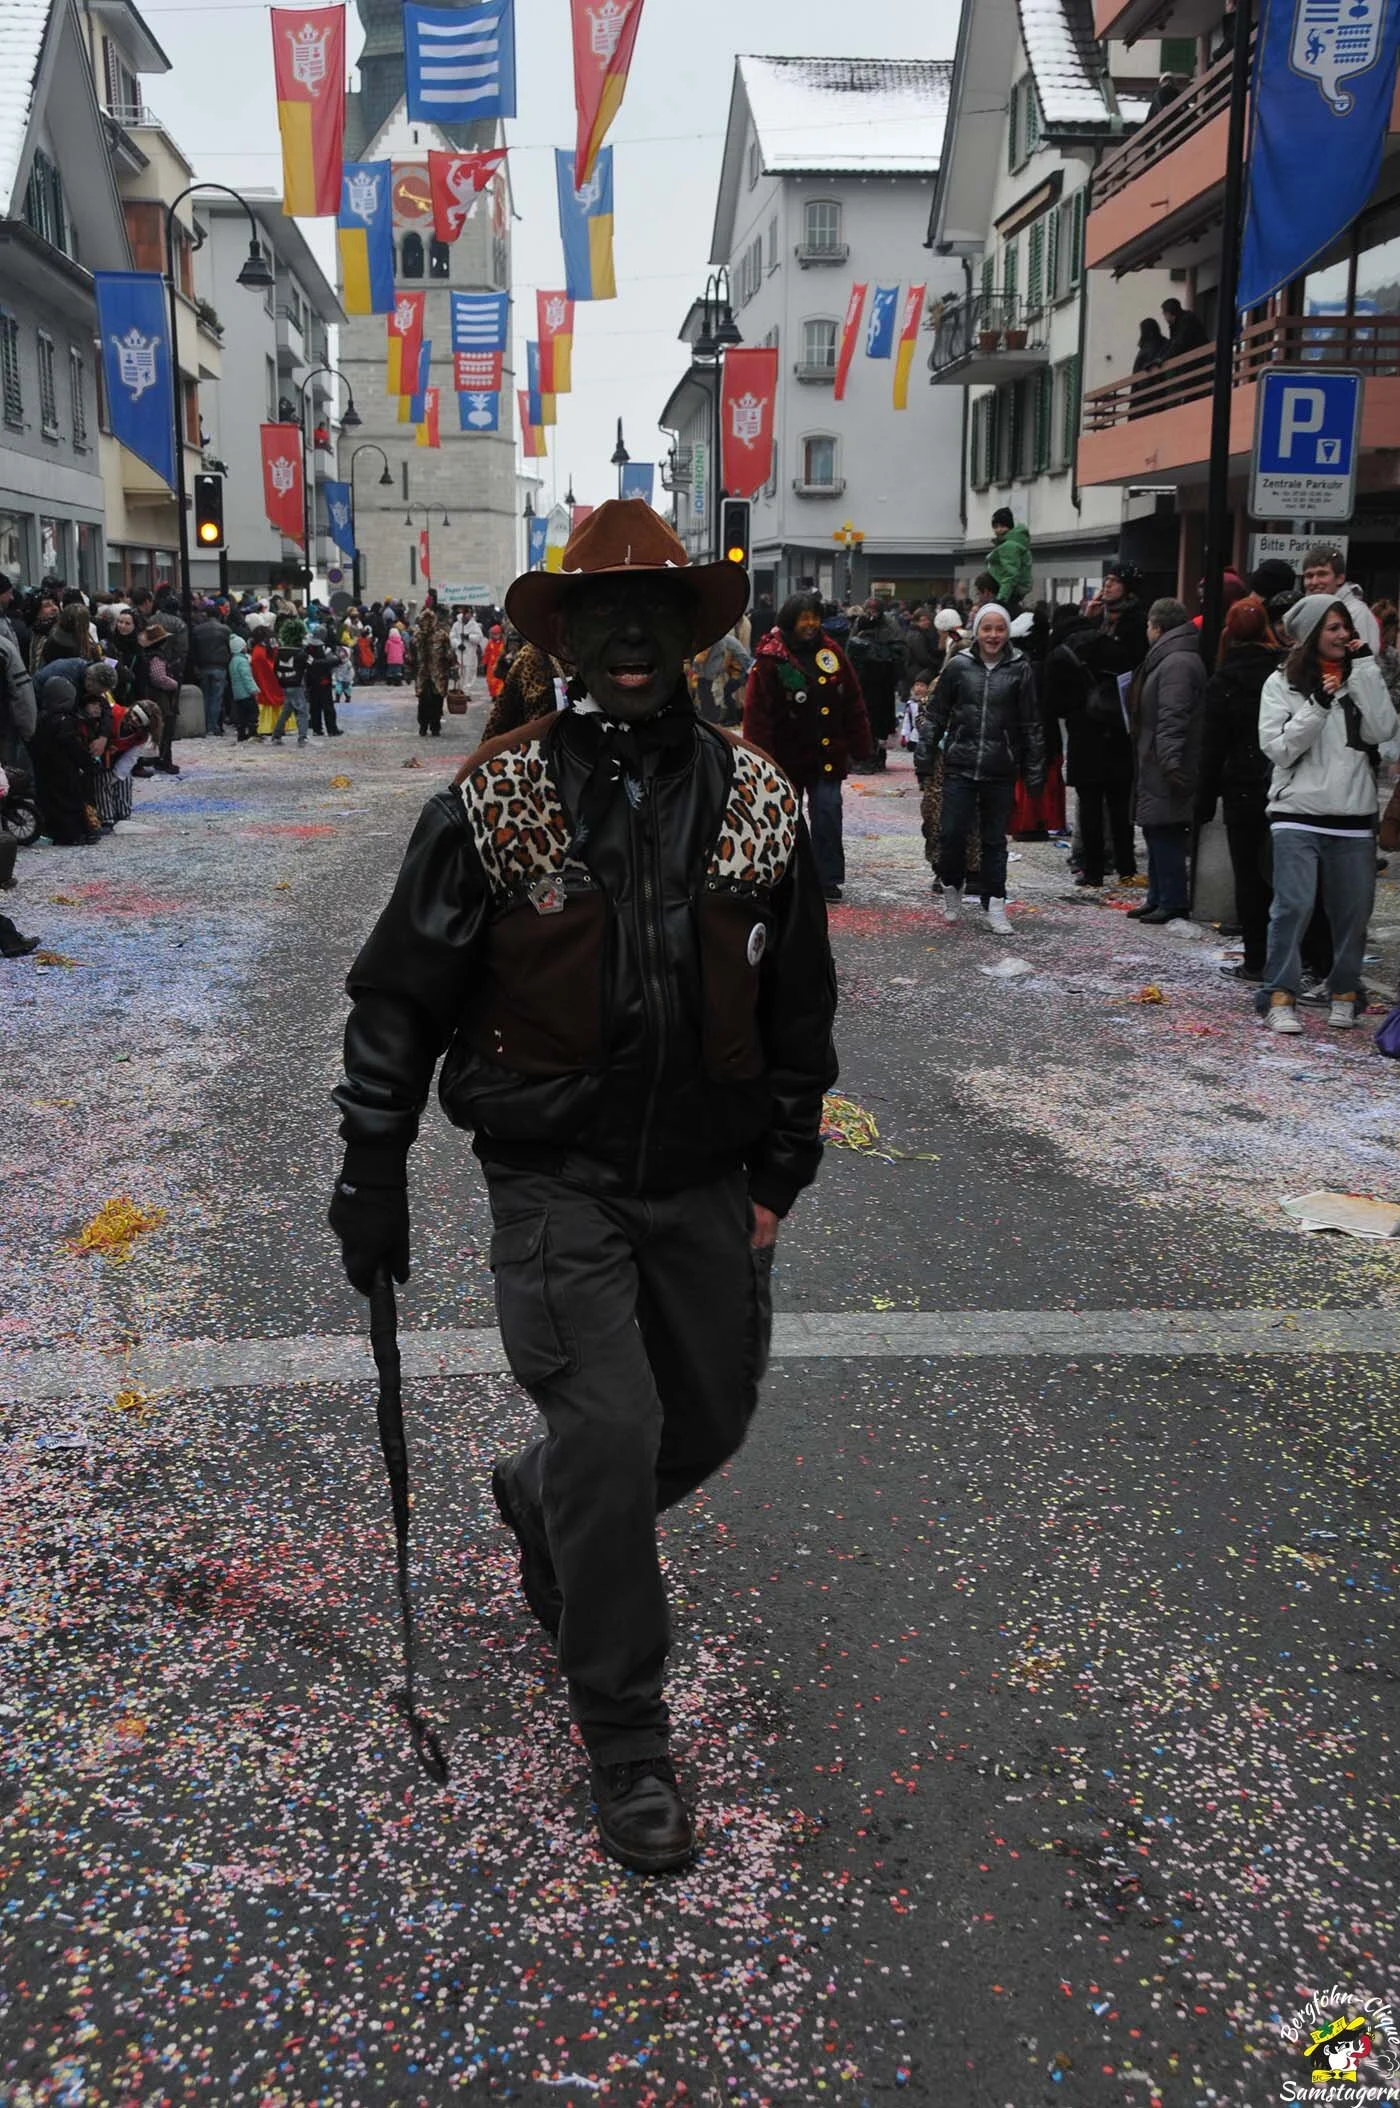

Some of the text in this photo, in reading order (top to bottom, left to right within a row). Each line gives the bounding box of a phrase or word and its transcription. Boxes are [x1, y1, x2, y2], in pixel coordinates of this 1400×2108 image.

[1278, 387, 1326, 458] P
[1262, 478, 1344, 490] Zentrale Parkuhr
[1260, 537, 1286, 551] Bitte
